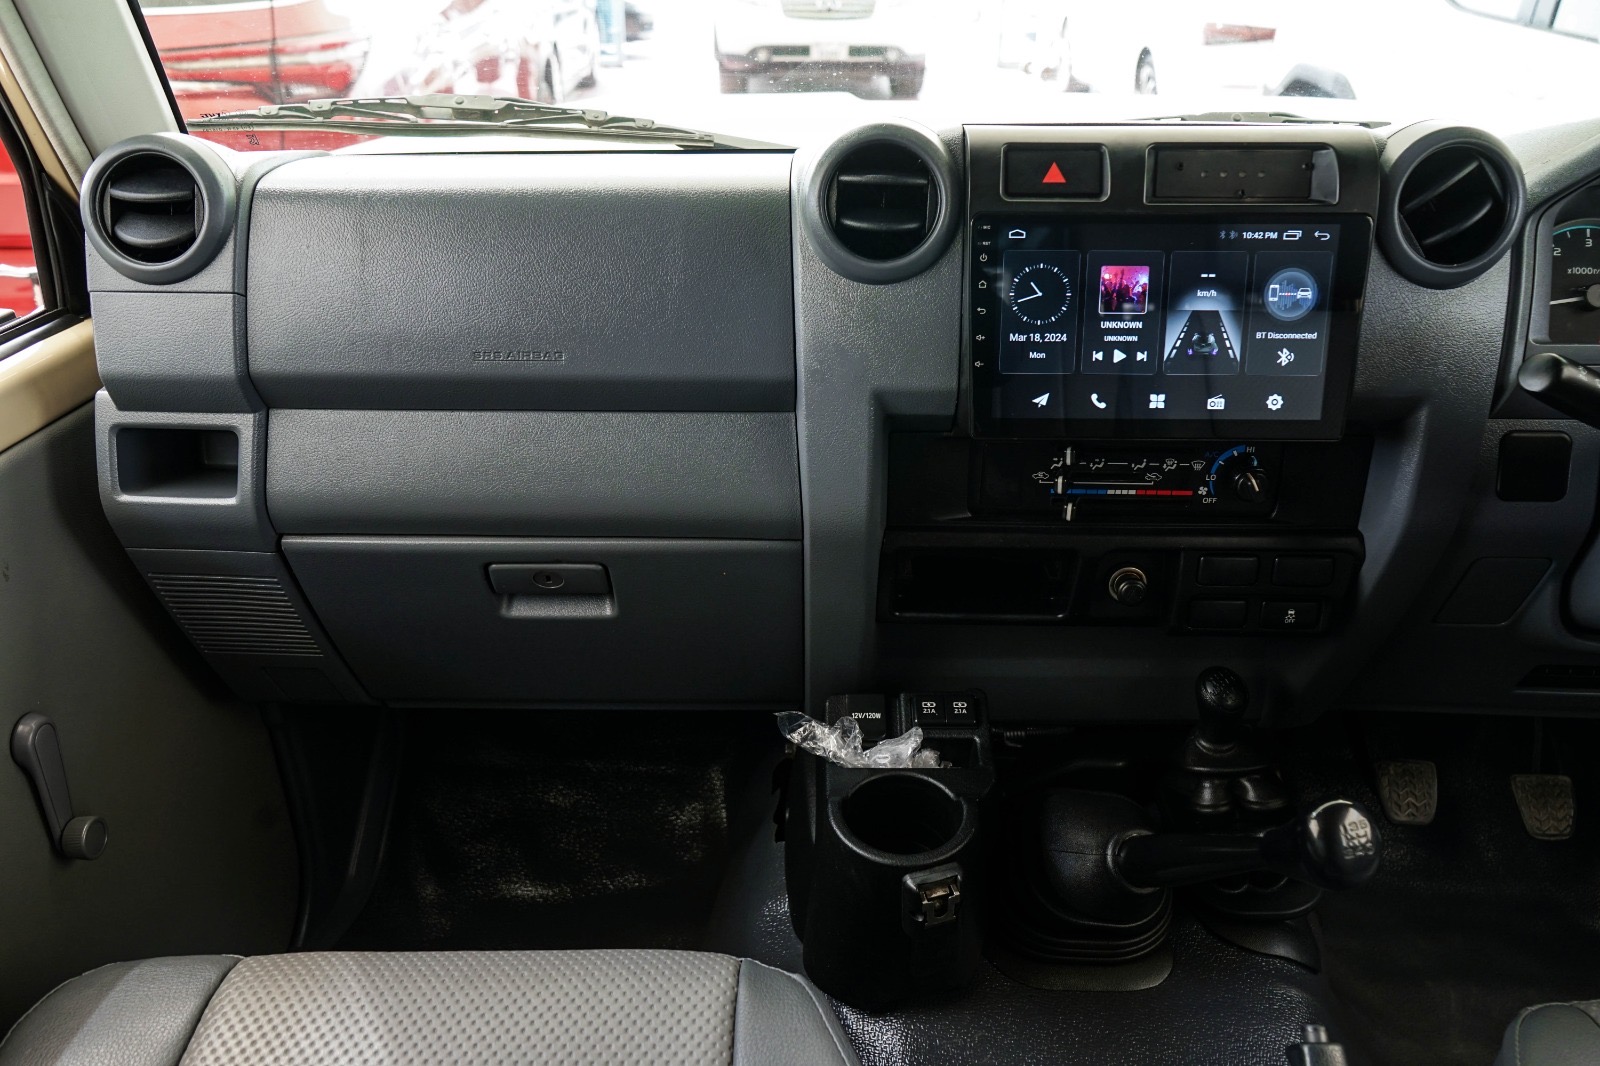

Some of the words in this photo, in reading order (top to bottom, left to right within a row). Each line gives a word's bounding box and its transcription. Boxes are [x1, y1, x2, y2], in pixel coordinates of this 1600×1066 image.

[1242, 231, 1264, 239] 10:42
[1265, 231, 1278, 239] PM
[1585, 239, 1593, 247] 3
[1553, 247, 1562, 256] 2
[1197, 289, 1216, 297] km/h
[1100, 320, 1143, 329] UNKNOWN
[1009, 333, 1028, 342] Mar
[1029, 333, 1043, 343] 18,
[1044, 333, 1067, 342] 2024
[1256, 331, 1267, 339] BT
[1267, 331, 1318, 340] Disconnected
[473, 351, 503, 360] SRS
[506, 351, 565, 360] AIRBAG
[1029, 351, 1046, 359] Mon
